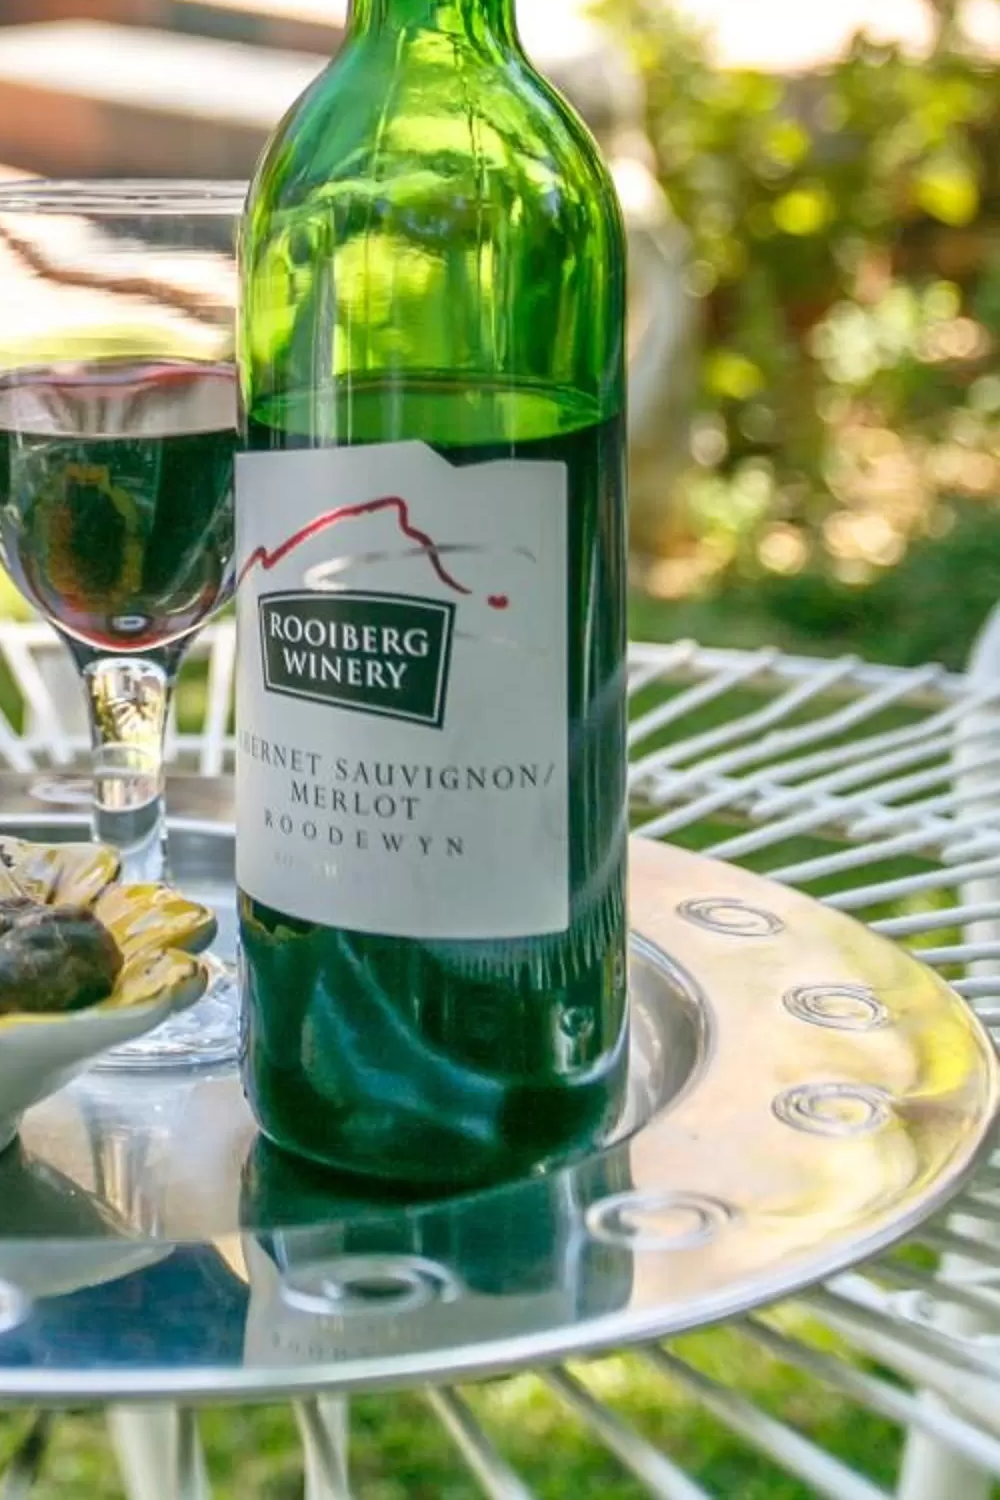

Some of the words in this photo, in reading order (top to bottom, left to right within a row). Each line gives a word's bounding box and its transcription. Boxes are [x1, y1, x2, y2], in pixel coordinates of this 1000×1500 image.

[269, 611, 429, 657] ROOIBERG
[283, 646, 408, 690] WINERY
[335, 756, 555, 790] SAUVIGNON/
[291, 779, 420, 820] MERLOT
[264, 806, 464, 856] ROODEWYN
